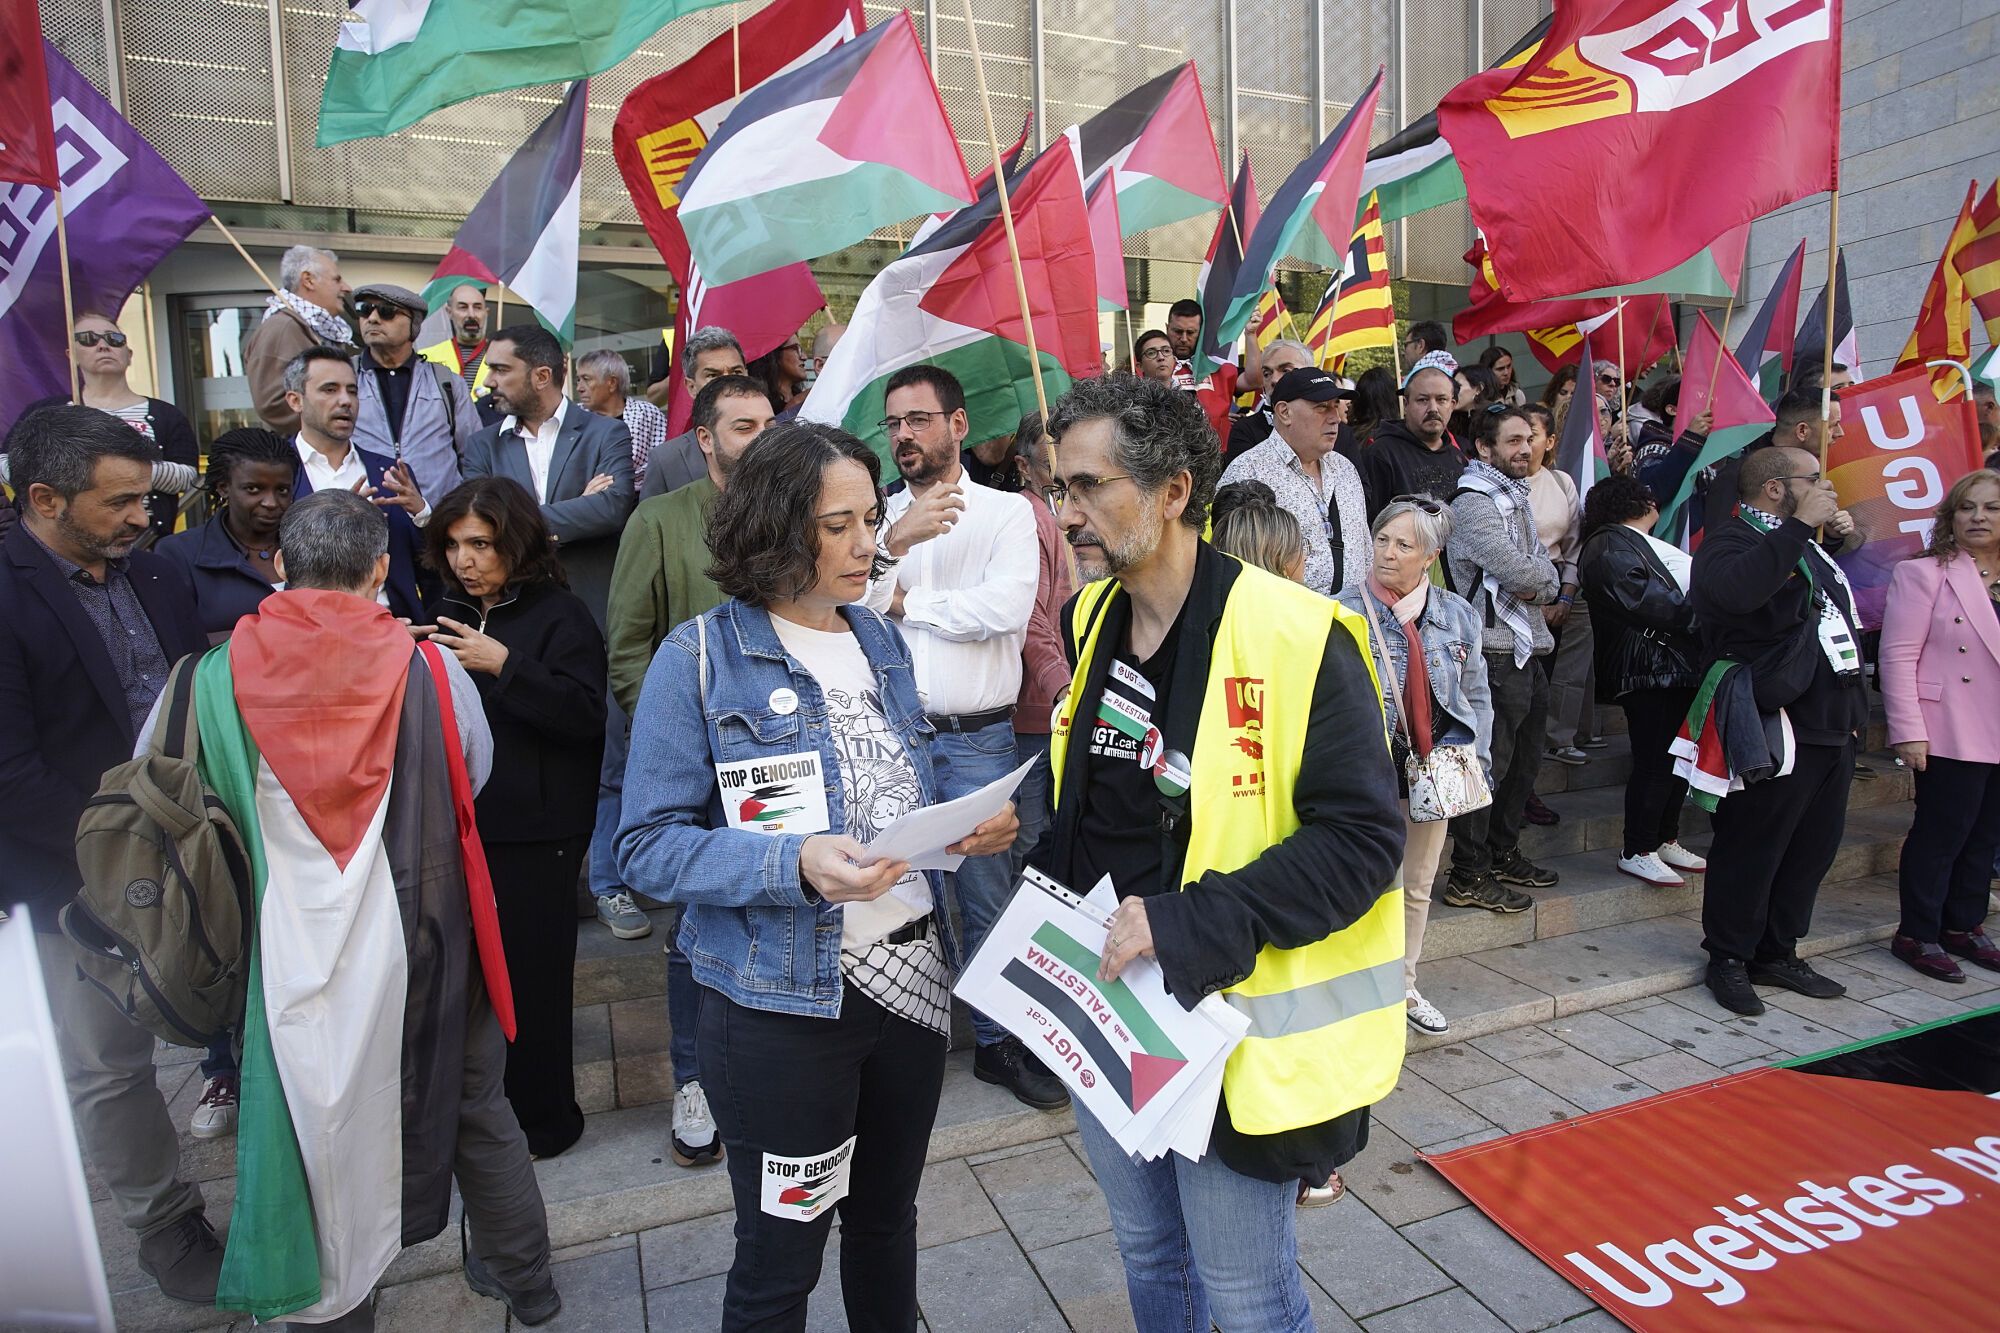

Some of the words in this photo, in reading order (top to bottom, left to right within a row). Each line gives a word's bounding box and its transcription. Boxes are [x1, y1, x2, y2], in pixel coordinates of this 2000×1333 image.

[1113, 698, 1149, 724] PALESTINA
[720, 769, 747, 788] STOP
[751, 759, 816, 785] GENOCIDI
[1026, 946, 1112, 1025] PALESTINA
[1026, 1007, 1083, 1072] UGT.cat
[1113, 1024, 1130, 1043] amb
[767, 1160, 800, 1178] STOP
[804, 1143, 851, 1178] GENOCIDI
[1563, 1164, 1965, 1307] Ugetistes
